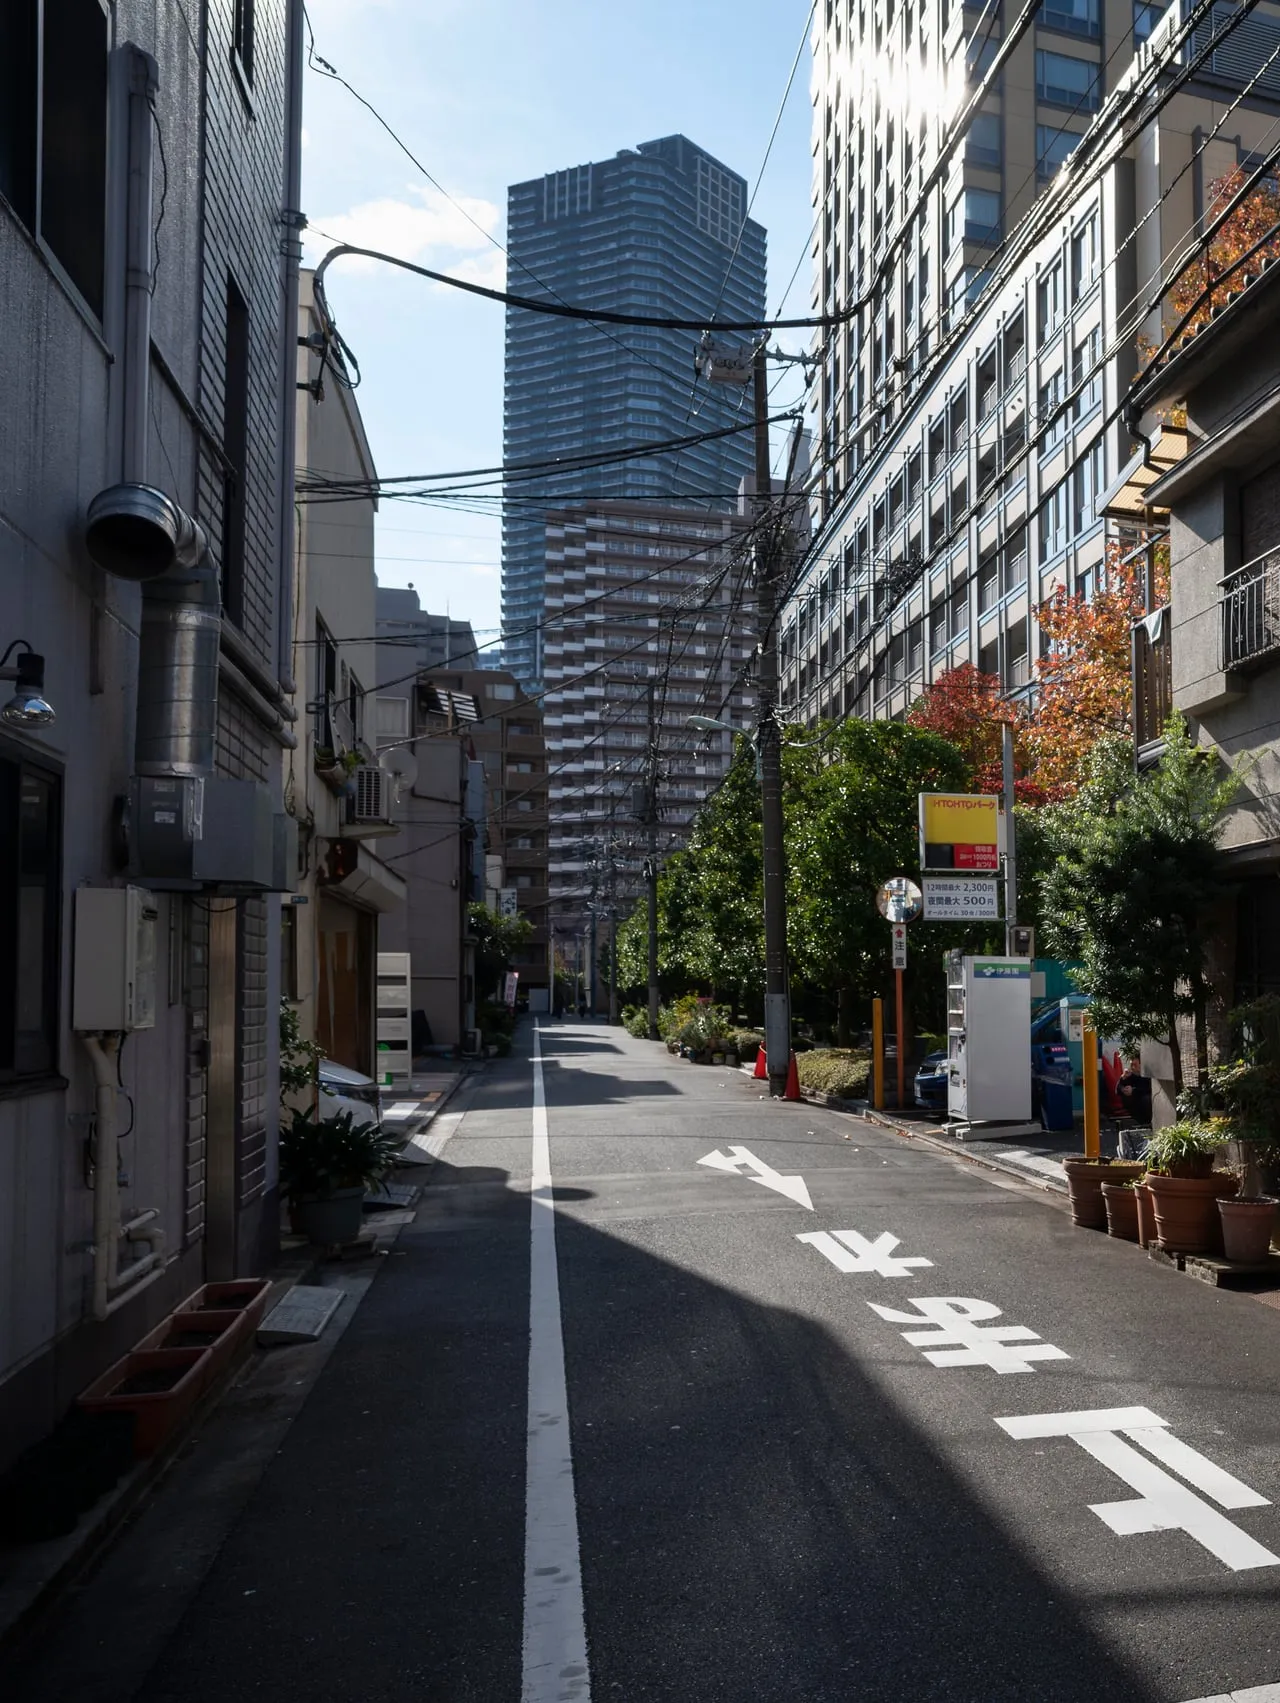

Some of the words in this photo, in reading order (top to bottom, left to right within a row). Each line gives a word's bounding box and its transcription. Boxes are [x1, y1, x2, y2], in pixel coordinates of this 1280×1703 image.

[963, 883, 994, 893] 2,300円
[927, 896, 961, 906] 夜間最大
[963, 896, 994, 906] 500円
[895, 941, 904, 966] 注意
